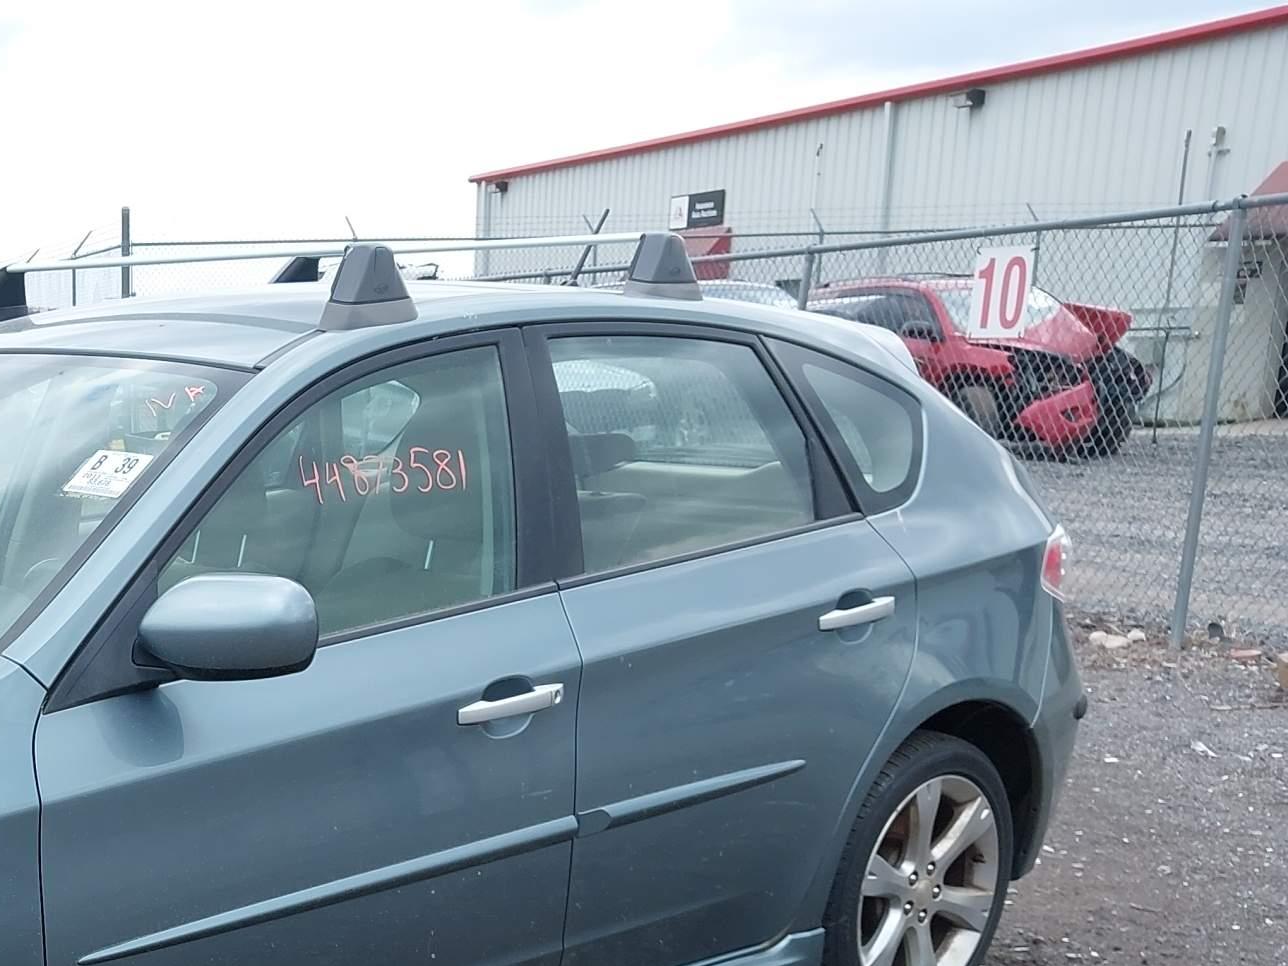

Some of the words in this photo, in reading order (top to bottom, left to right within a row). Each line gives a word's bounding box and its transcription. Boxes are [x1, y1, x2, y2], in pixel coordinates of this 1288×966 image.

[978, 256, 1027, 329] 10
[114, 457, 140, 475] 39
[298, 447, 467, 504] 44873581
